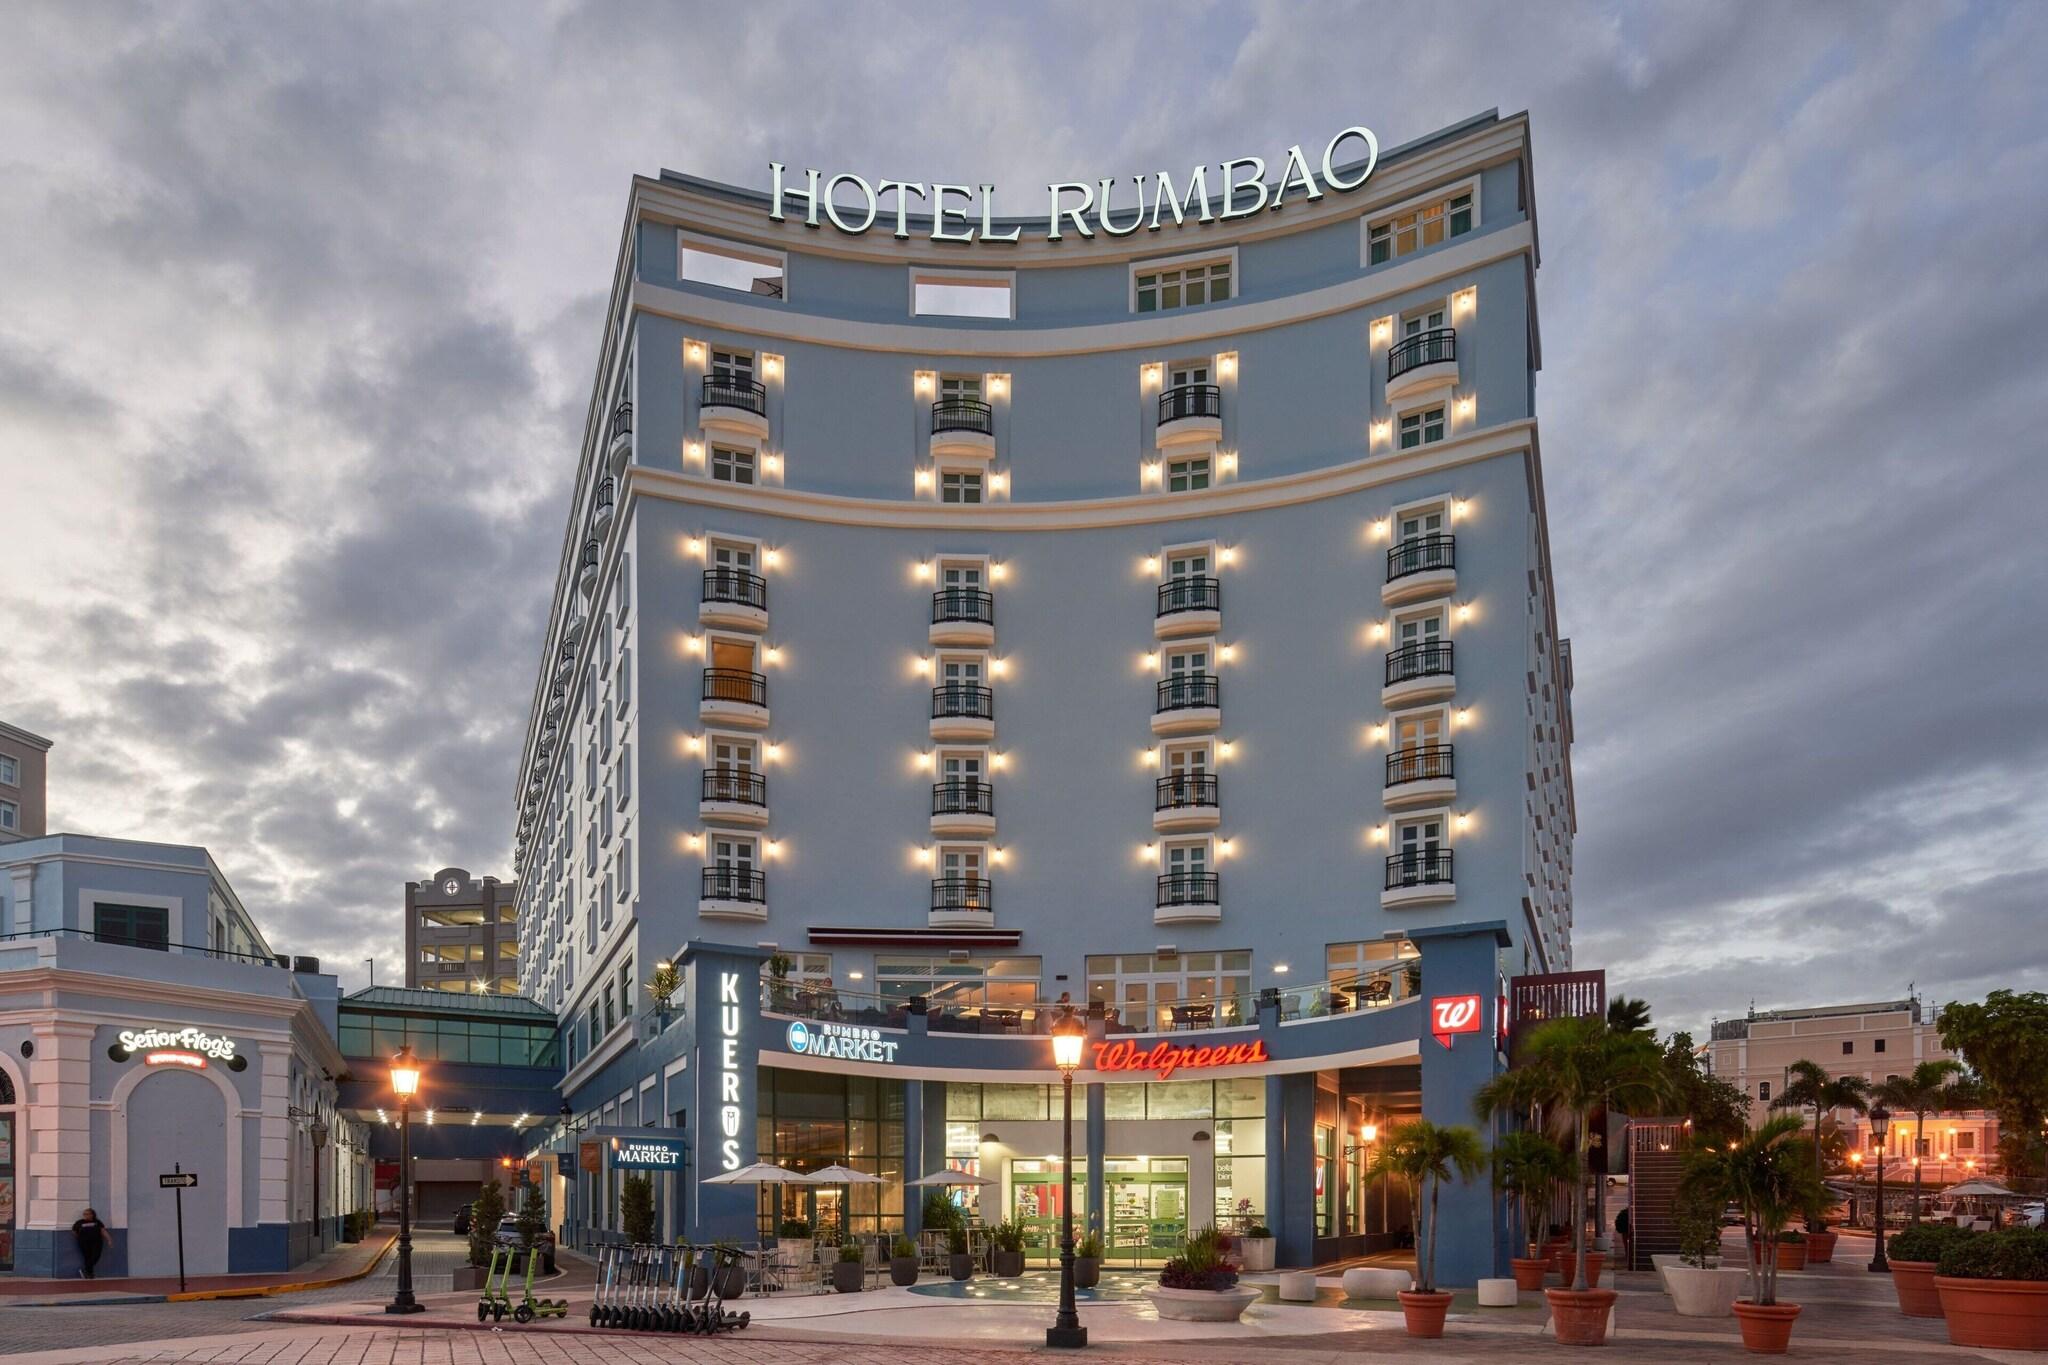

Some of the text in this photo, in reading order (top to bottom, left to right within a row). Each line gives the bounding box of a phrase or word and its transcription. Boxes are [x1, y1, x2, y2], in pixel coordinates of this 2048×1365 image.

[769, 126, 1379, 244] HOTEL RUMBAO
[119, 1029, 180, 1052] Señor
[180, 1027, 235, 1060] Frog's
[807, 1033, 898, 1062] MARKET
[823, 1024, 880, 1041] RUMBAO
[721, 972, 741, 1170] KUEROS
[1092, 1039, 1268, 1081] Walgreens
[618, 1150, 680, 1164] MARKET
[629, 1144, 668, 1152] RUMBAO
